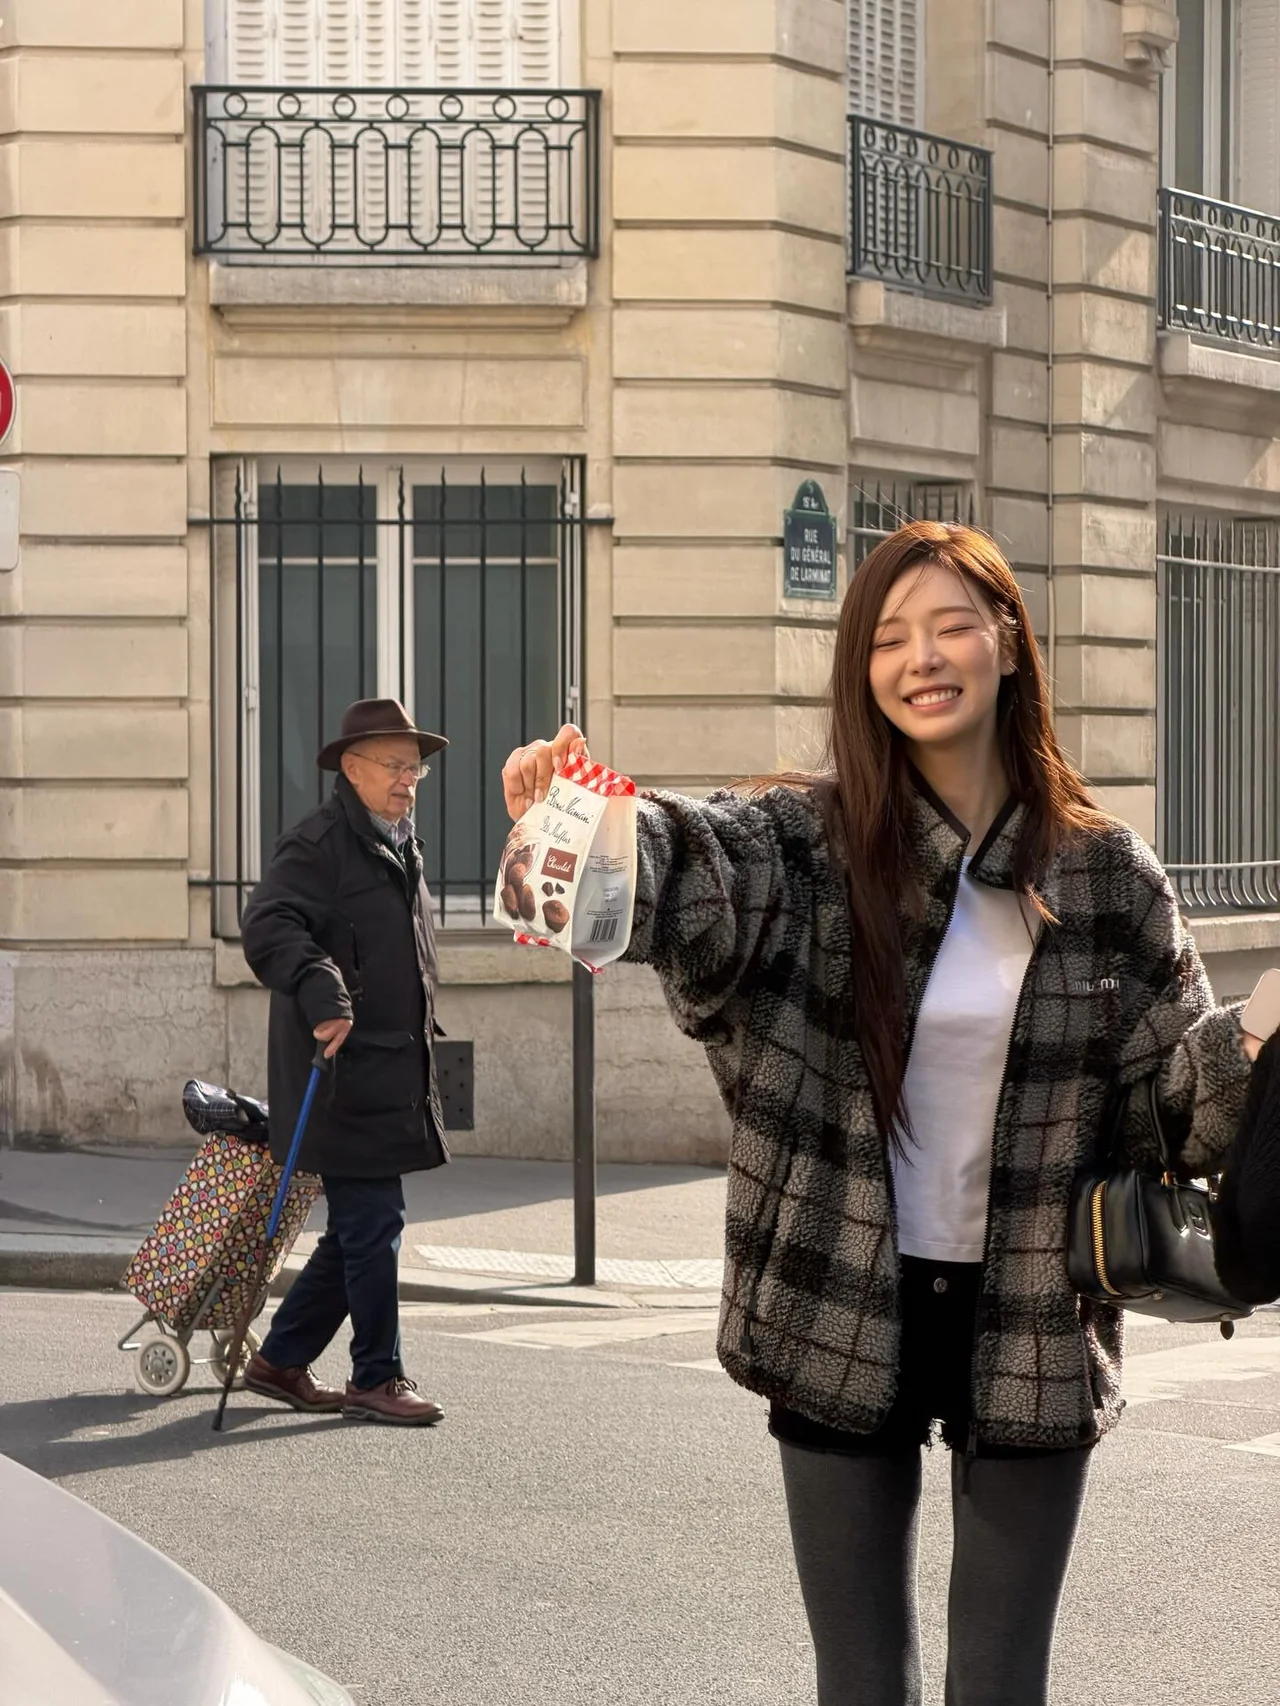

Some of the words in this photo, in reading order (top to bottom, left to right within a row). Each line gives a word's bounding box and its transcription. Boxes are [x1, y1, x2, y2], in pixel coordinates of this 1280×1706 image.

[804, 528, 818, 544] RUE
[790, 546, 800, 562] DU
[802, 545, 831, 565] GÉNÉRAL
[790, 566, 800, 582] DE
[800, 567, 831, 584] LARMINAT
[565, 796, 589, 824] Maman
[547, 854, 572, 873] Chocolat
